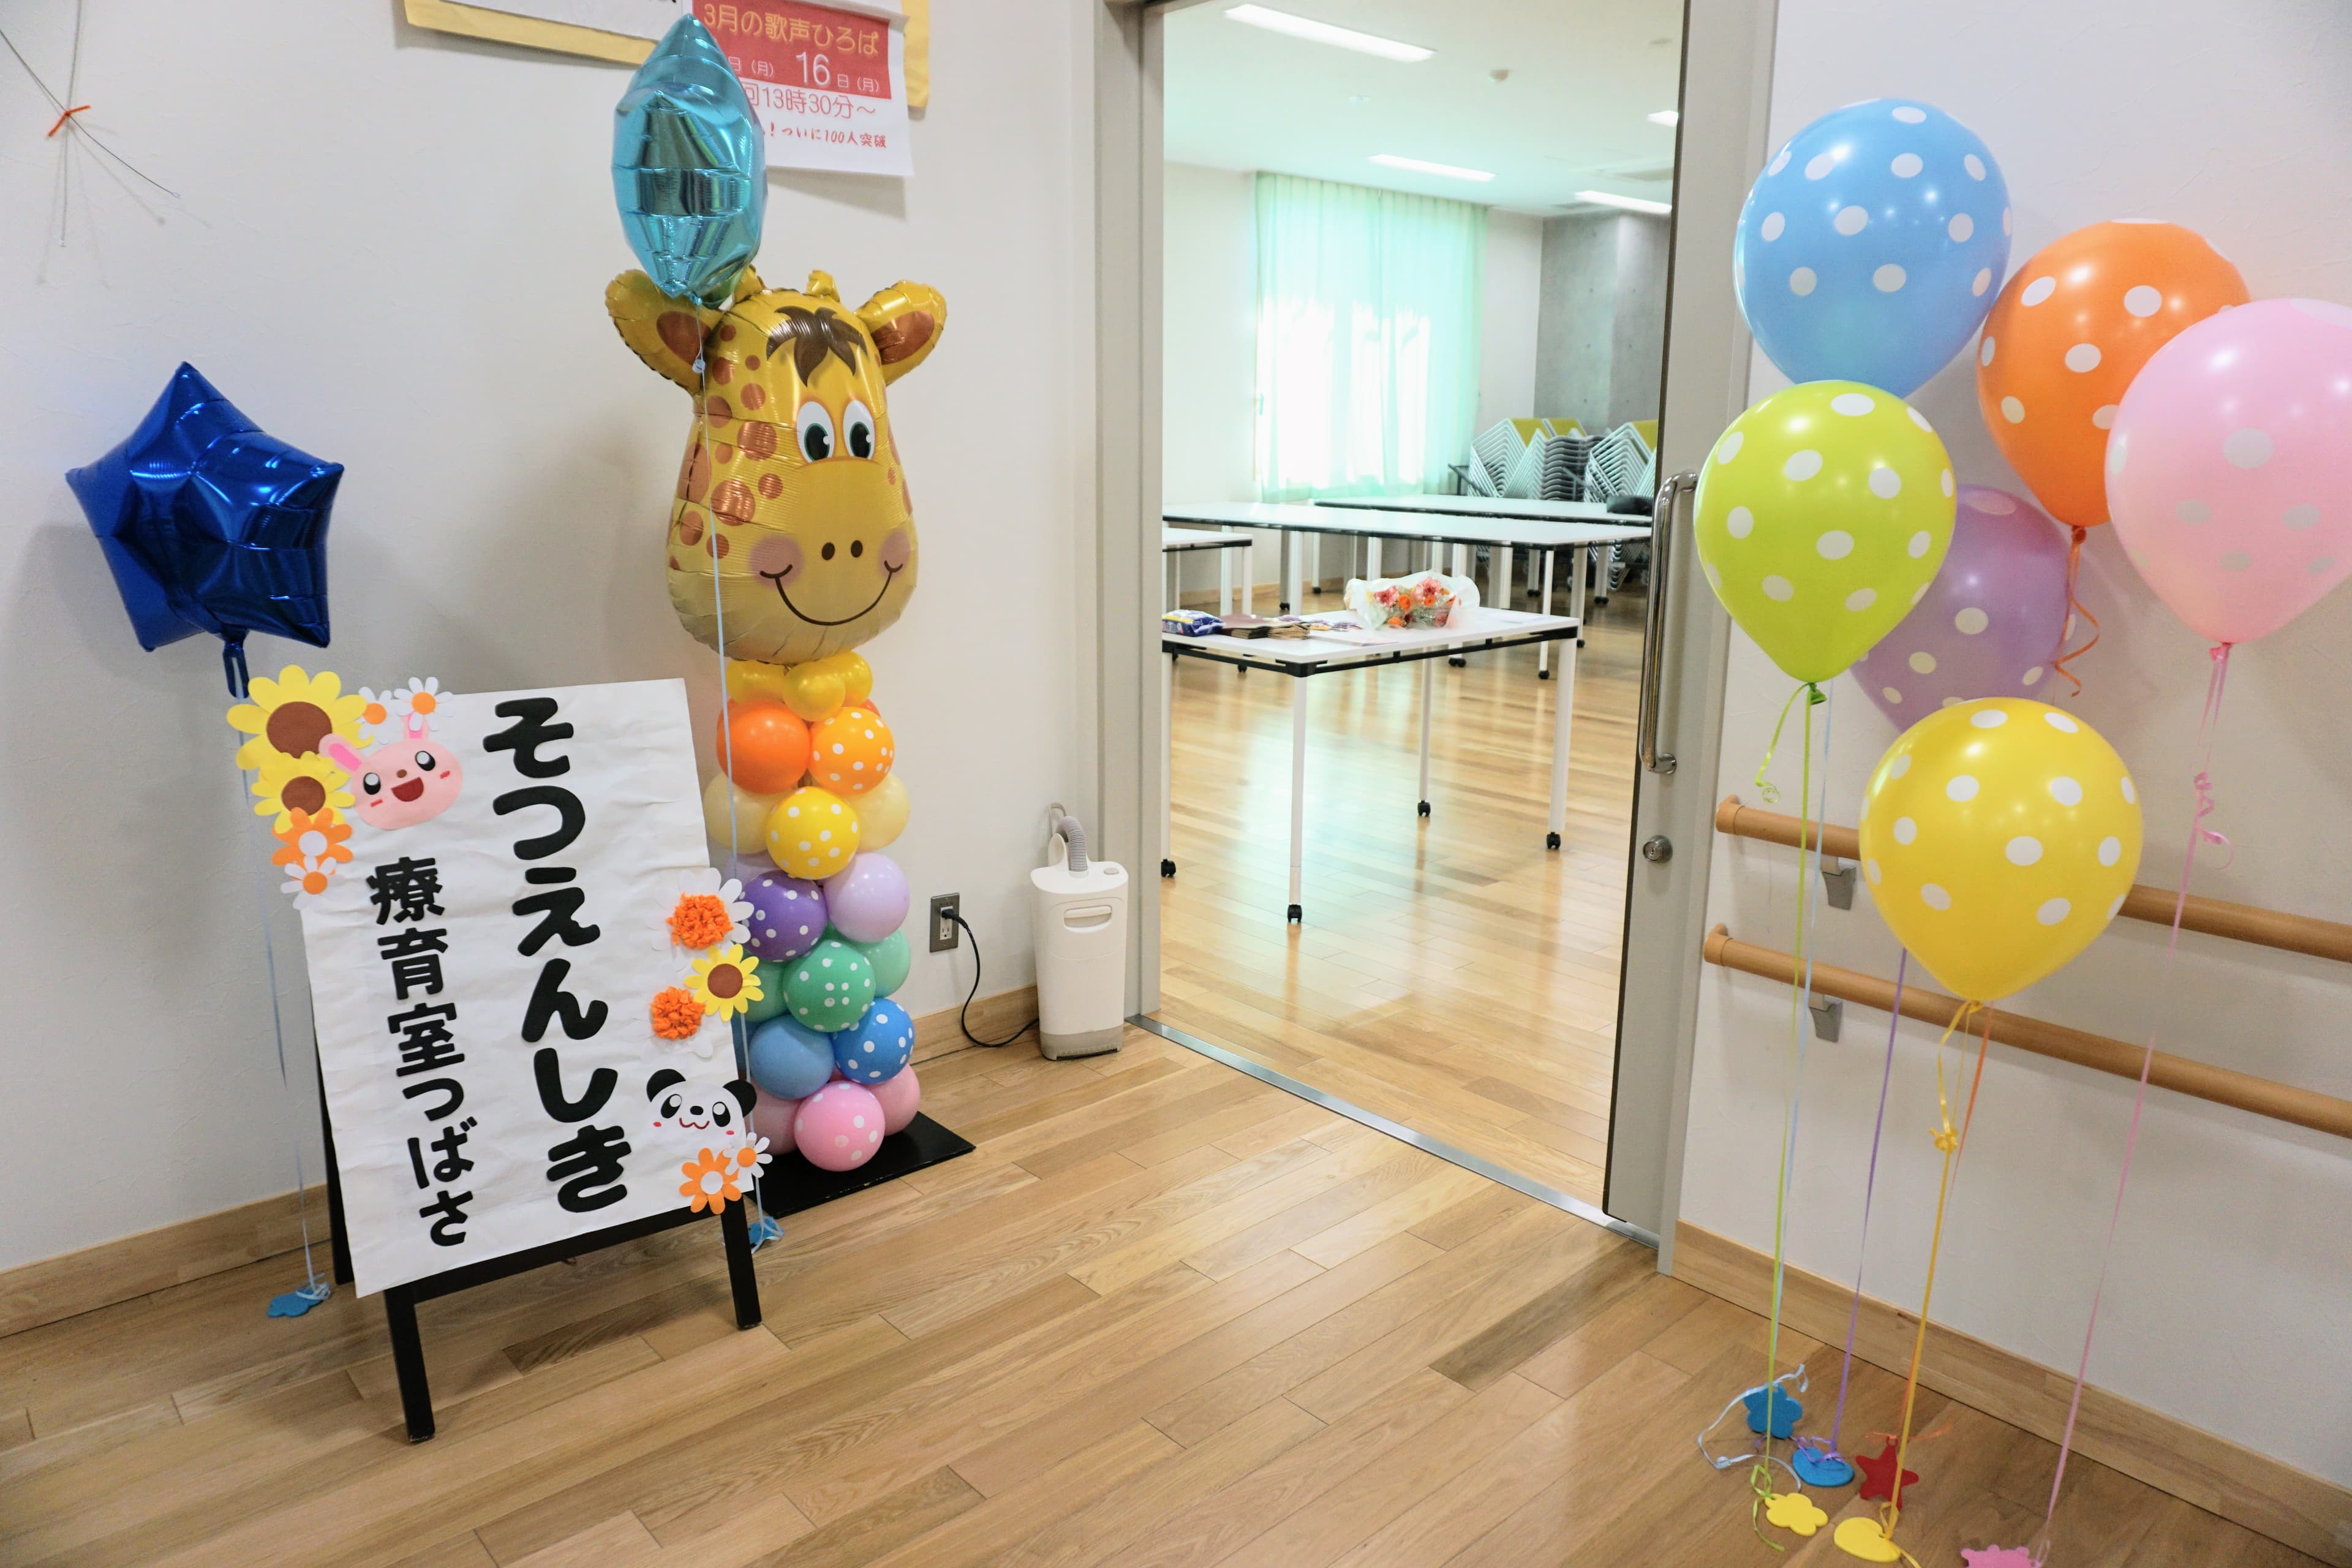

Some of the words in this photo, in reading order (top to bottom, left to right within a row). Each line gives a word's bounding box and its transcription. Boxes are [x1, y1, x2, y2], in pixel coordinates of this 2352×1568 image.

[366, 856, 479, 1247] 療育室つばさ
[482, 696, 633, 1213] そつえんしき
